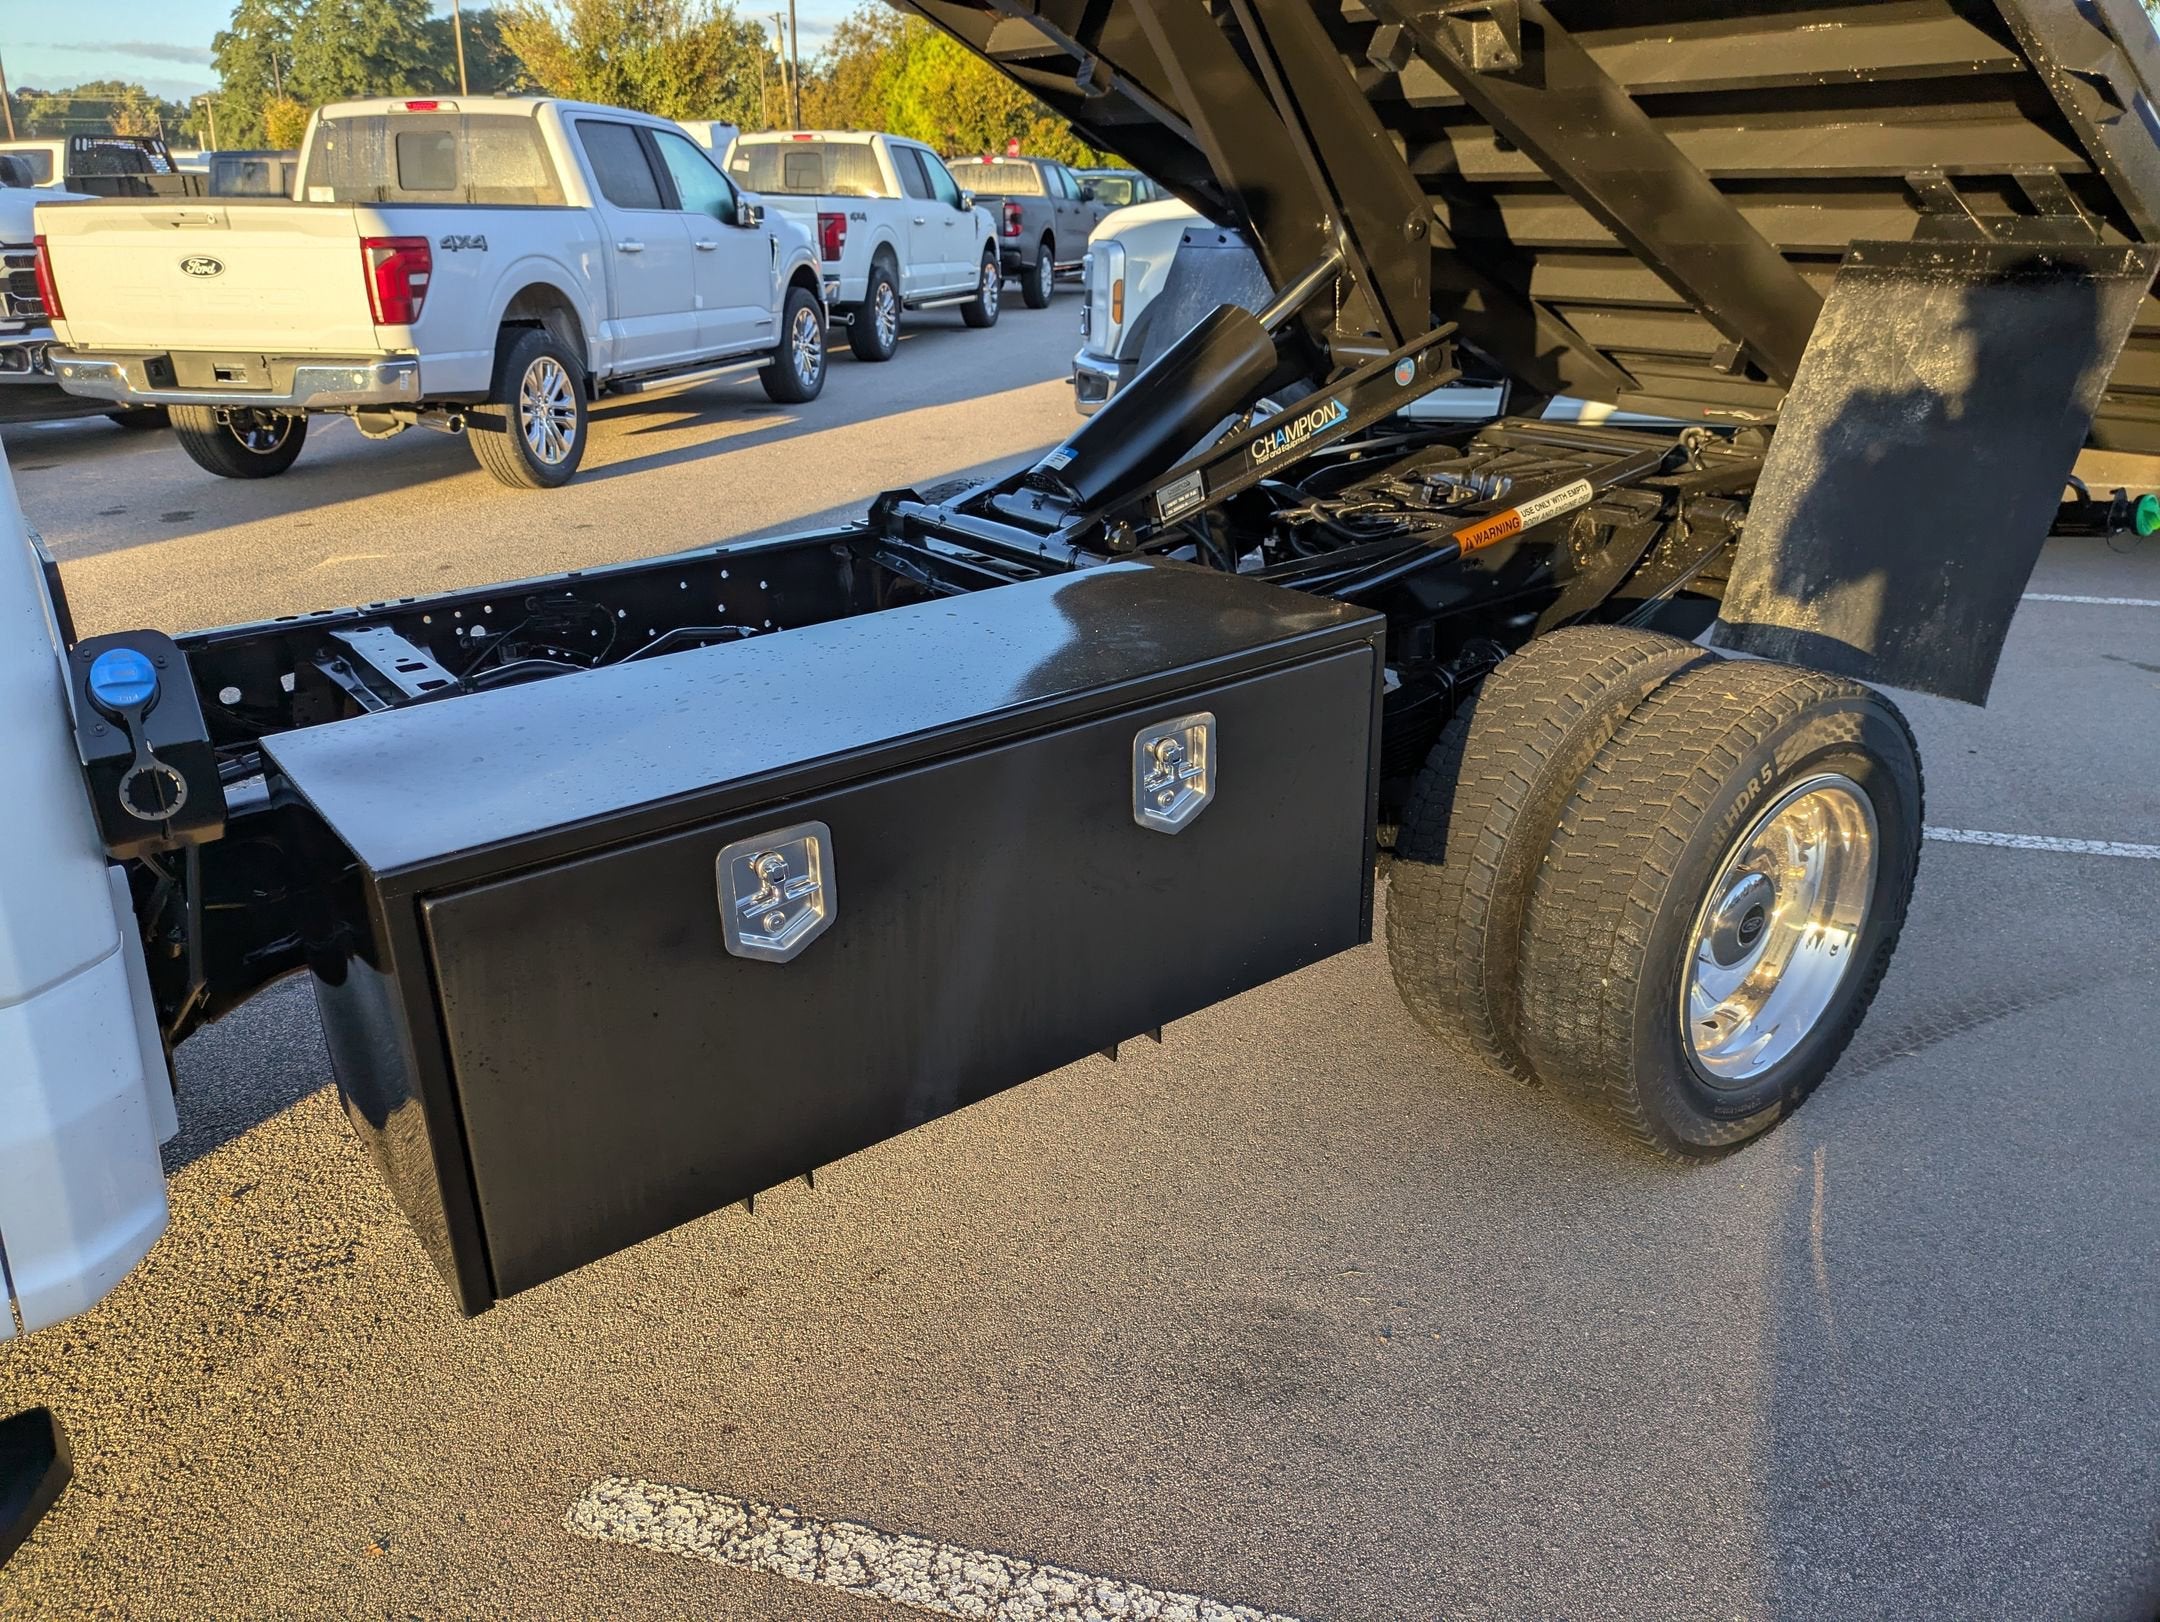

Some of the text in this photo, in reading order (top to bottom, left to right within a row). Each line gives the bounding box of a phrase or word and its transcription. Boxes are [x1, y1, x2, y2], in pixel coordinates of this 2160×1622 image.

[186, 259, 217, 274] Ford
[1251, 402, 1336, 459] CHAMPION
[1255, 450, 1270, 466] Hoist
[1269, 445, 1282, 458] and
[1281, 432, 1311, 453] Equipment
[1520, 484, 1588, 518] USE ONLY WITH EMPTY
[1472, 517, 1521, 545] WARNING
[1723, 777, 1762, 828] HDR
[1760, 762, 1773, 785] 5
